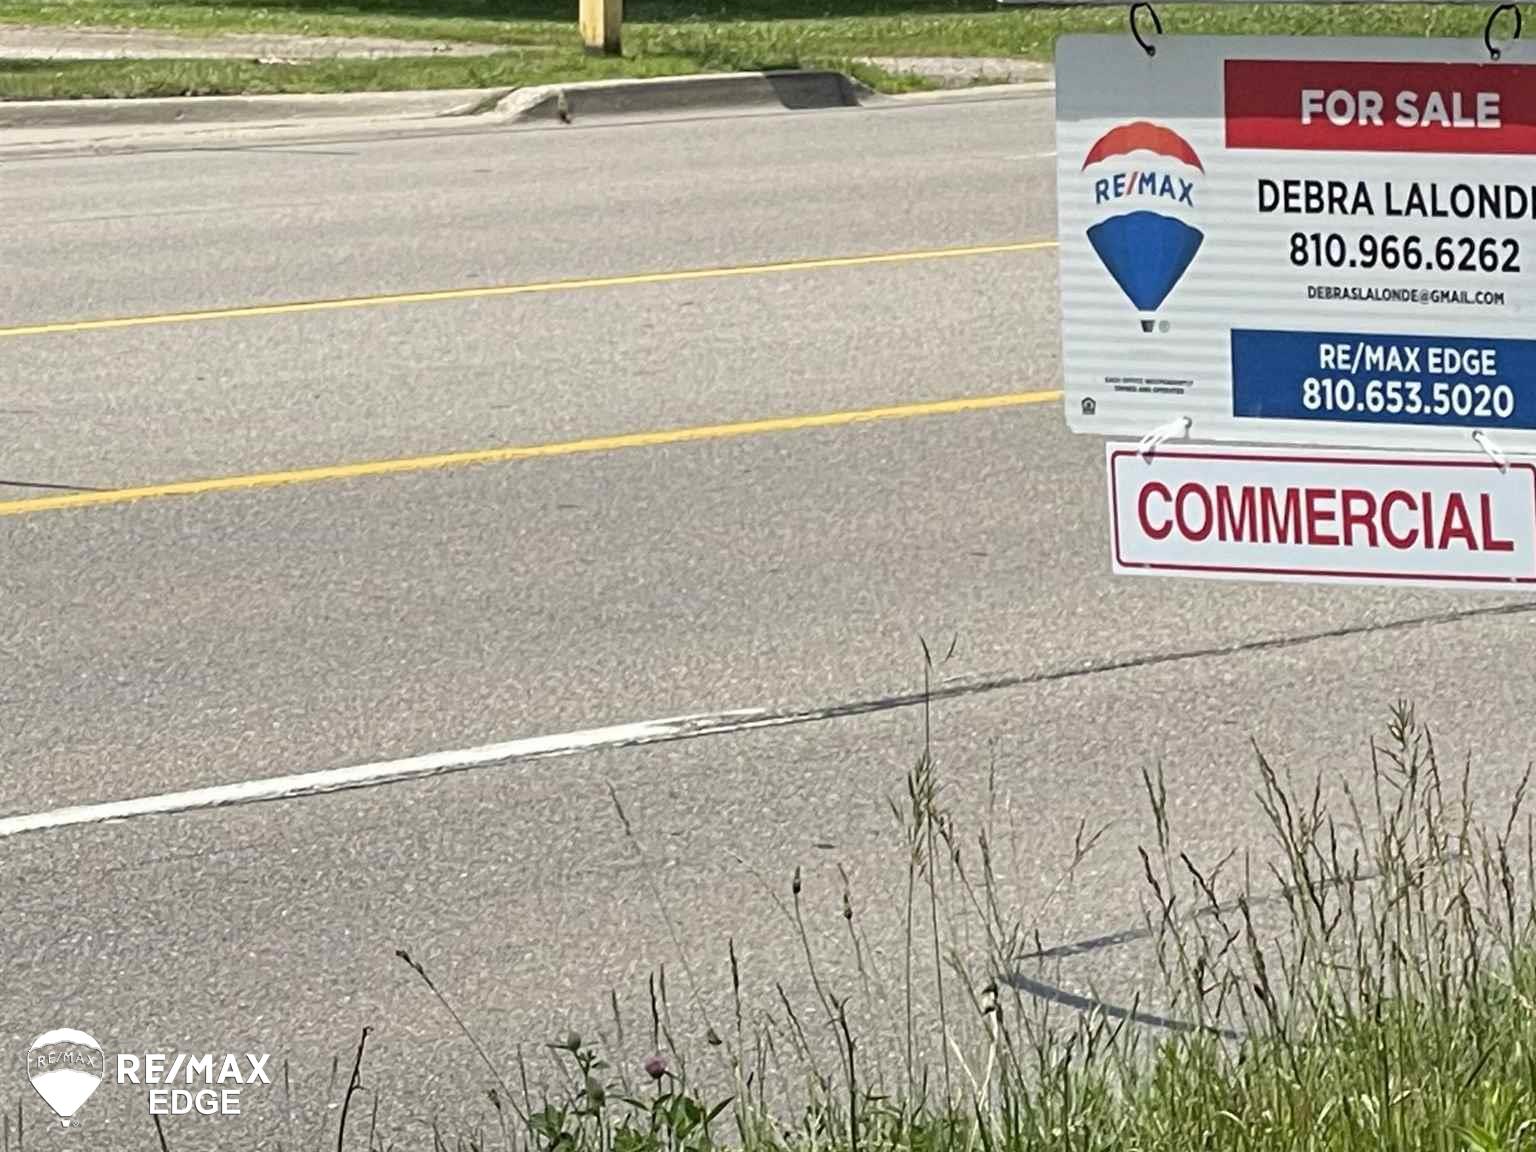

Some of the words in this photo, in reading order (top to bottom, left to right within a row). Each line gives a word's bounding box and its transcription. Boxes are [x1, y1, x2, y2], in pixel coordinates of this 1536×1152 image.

[1301, 89, 1384, 128] FOR
[1396, 91, 1501, 129] SALE
[1095, 171, 1194, 208] RE/MAX
[1258, 179, 1375, 217] DEBRA
[1289, 232, 1521, 273] 810.966.6262
[1307, 285, 1505, 306] DEBRASLALONDE@GMAIL.COM
[1319, 343, 1420, 373] RE/MAX
[1428, 347, 1497, 377] EDGE
[1302, 378, 1515, 419] 810.653.5020
[1137, 480, 1515, 552] COMMERCIAL
